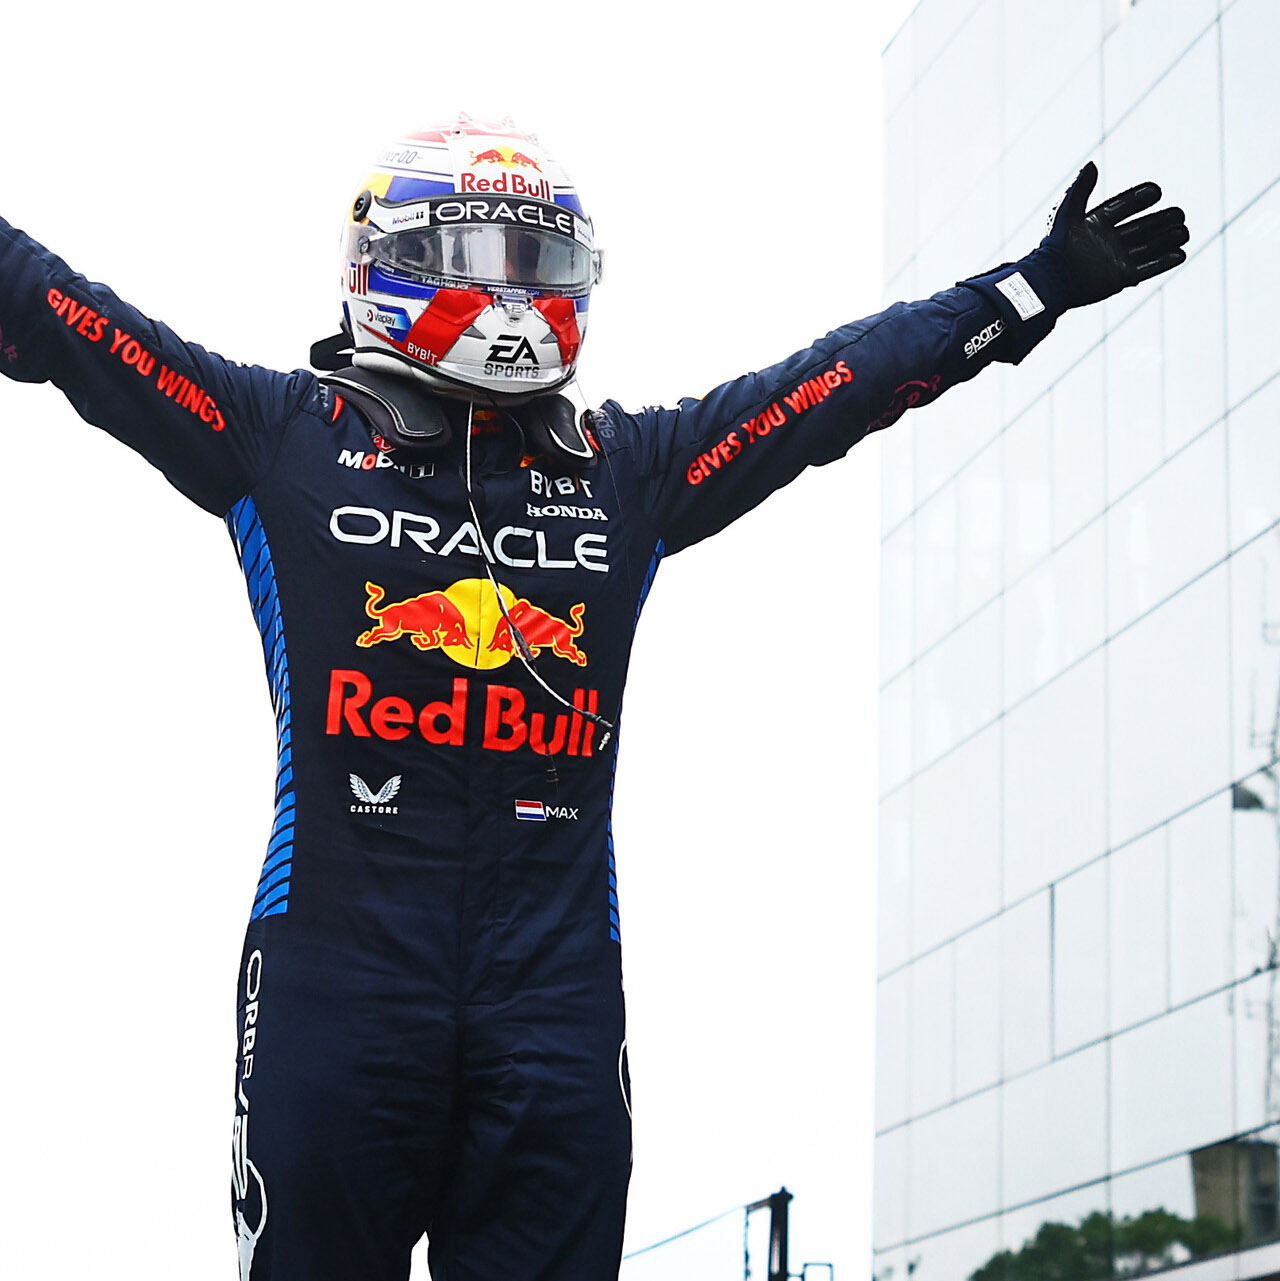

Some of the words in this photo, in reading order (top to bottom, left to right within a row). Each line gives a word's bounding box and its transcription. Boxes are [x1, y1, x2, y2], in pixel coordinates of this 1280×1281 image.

[461, 172, 507, 192] Red
[511, 174, 550, 200] Bull
[392, 212, 415, 224] Mobil
[435, 201, 571, 234] ORACLE
[46, 287, 110, 342] GIVES
[109, 328, 157, 377] YOU
[406, 342, 438, 366] BYBIT
[486, 335, 540, 365] EA
[483, 362, 540, 379] SPORTS
[686, 431, 743, 486] GIVES
[740, 402, 787, 444] YOU
[782, 360, 854, 414] WINGS
[526, 502, 608, 521] HONDA
[328, 505, 610, 573] ORACLE
[325, 668, 469, 746] Red
[482, 683, 599, 757] Bull
[349, 804, 399, 814] CASTORE
[545, 805, 579, 820] MAX
